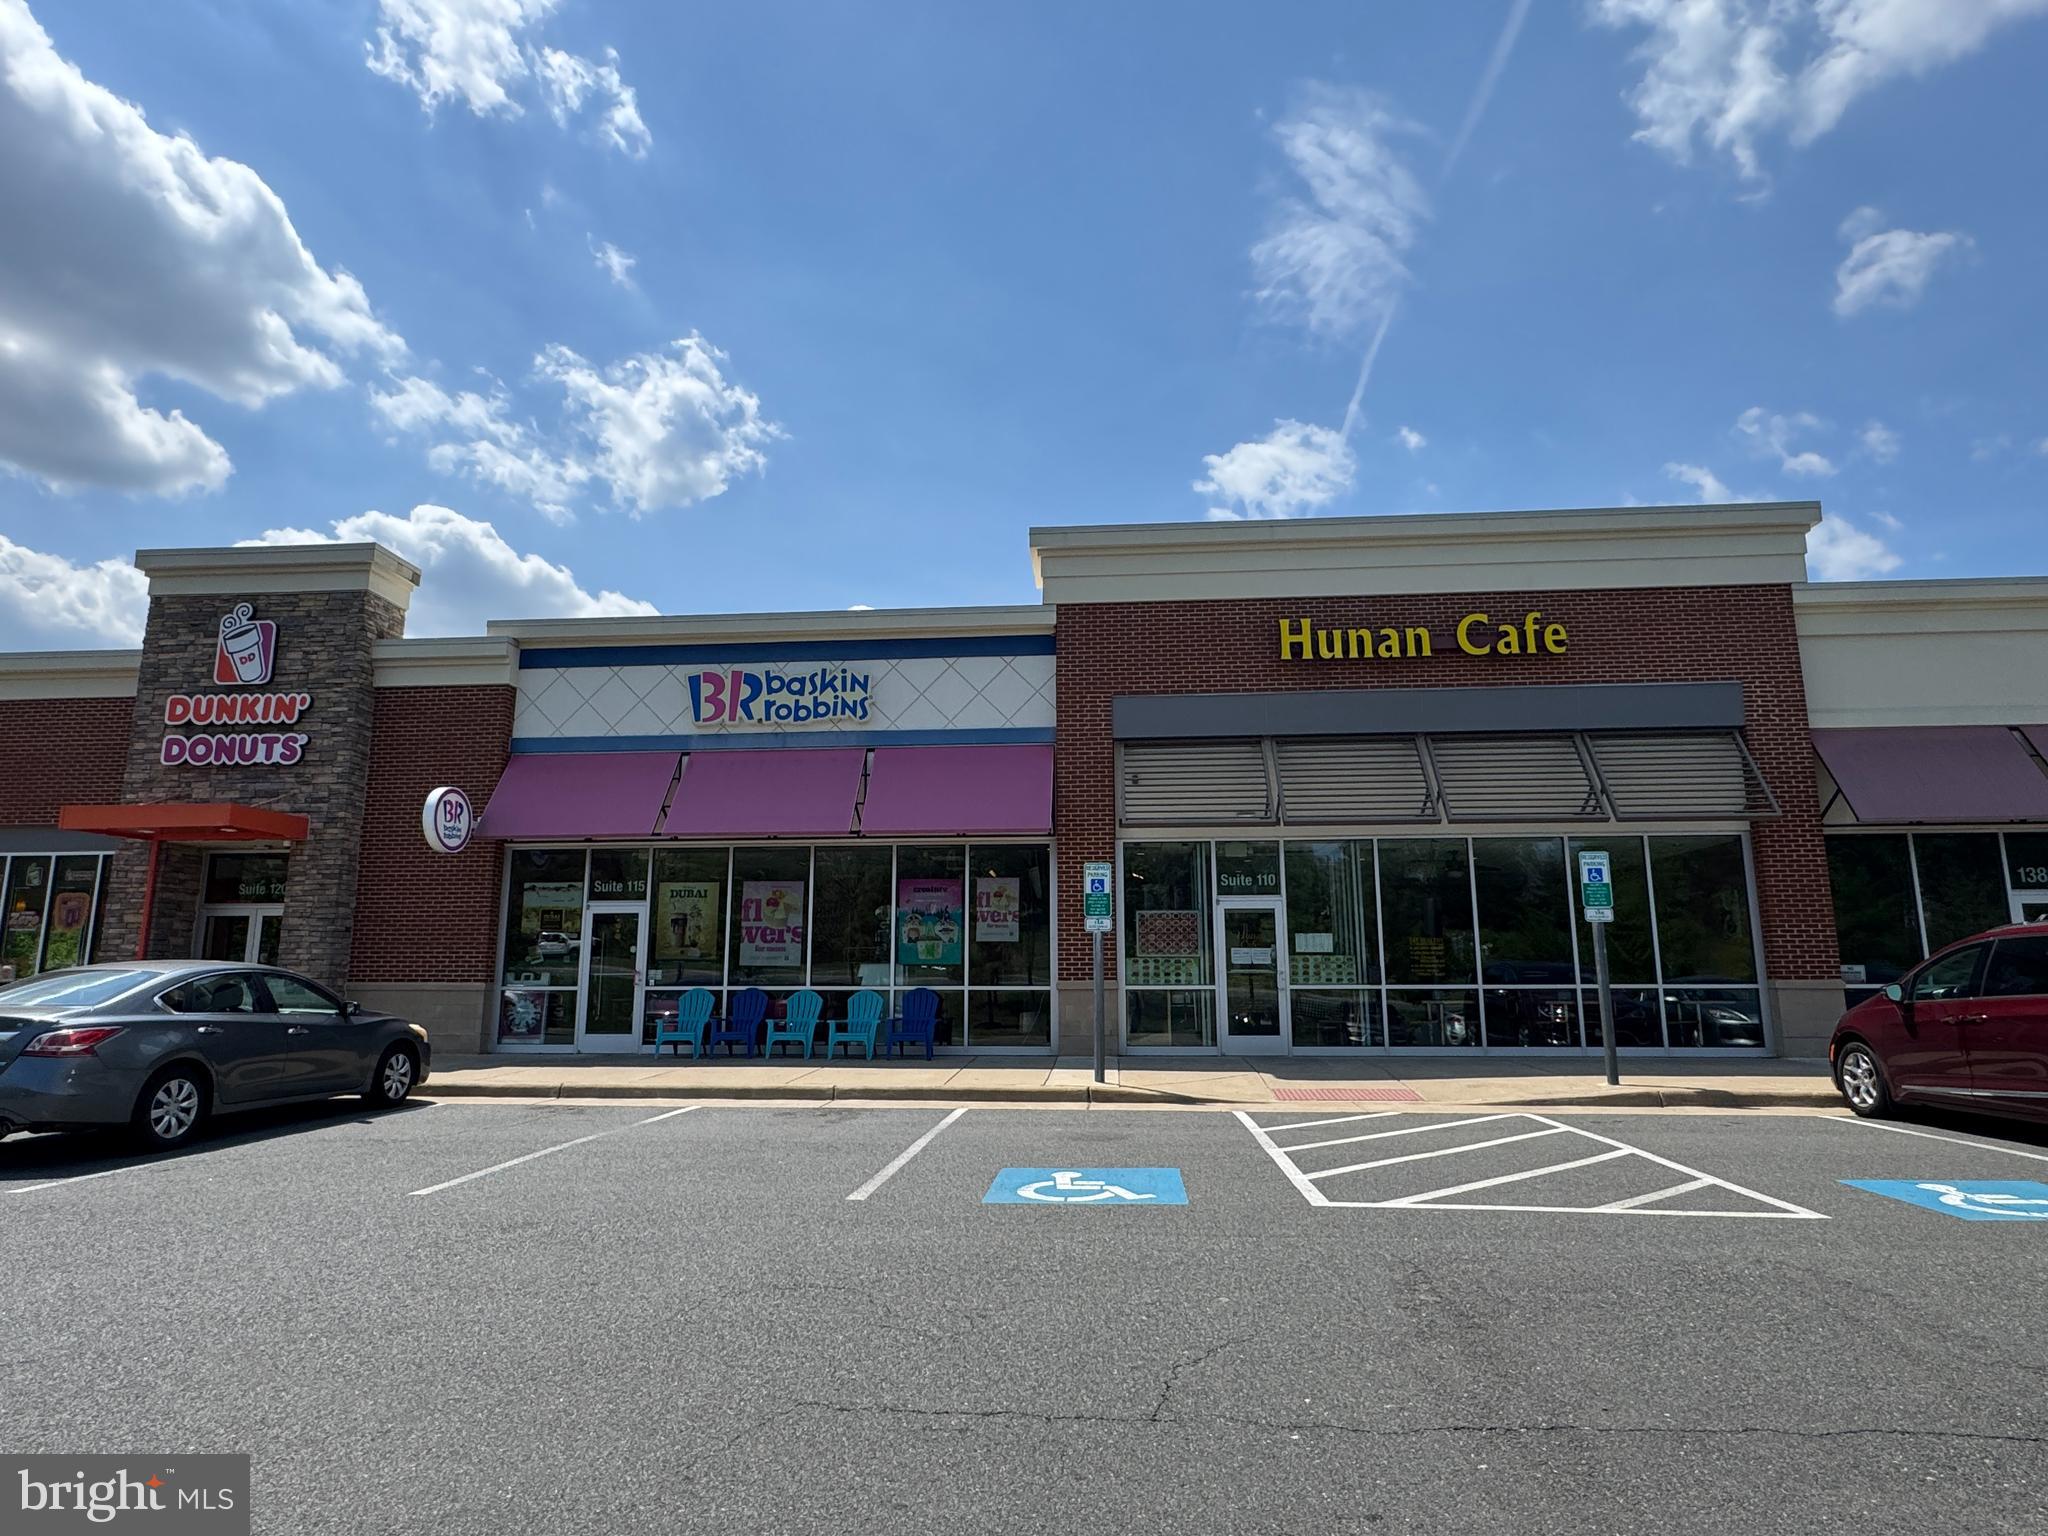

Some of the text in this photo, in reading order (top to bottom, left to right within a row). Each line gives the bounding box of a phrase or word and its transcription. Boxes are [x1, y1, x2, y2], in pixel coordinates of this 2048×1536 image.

[1278, 611, 1568, 660] Hunan Cafe
[238, 652, 257, 665] DD
[764, 667, 870, 697] baskin
[166, 694, 310, 724] DUNKIN'
[687, 670, 763, 723] BR
[764, 694, 870, 722] robbins
[162, 734, 301, 764] DONUTS
[443, 799, 464, 825] BR
[594, 880, 646, 893] Suite 115
[1220, 873, 1276, 887] Suite 110
[2016, 866, 2048, 883] 138
[238, 882, 266, 895] Suite
[669, 888, 709, 899] DUBAI
